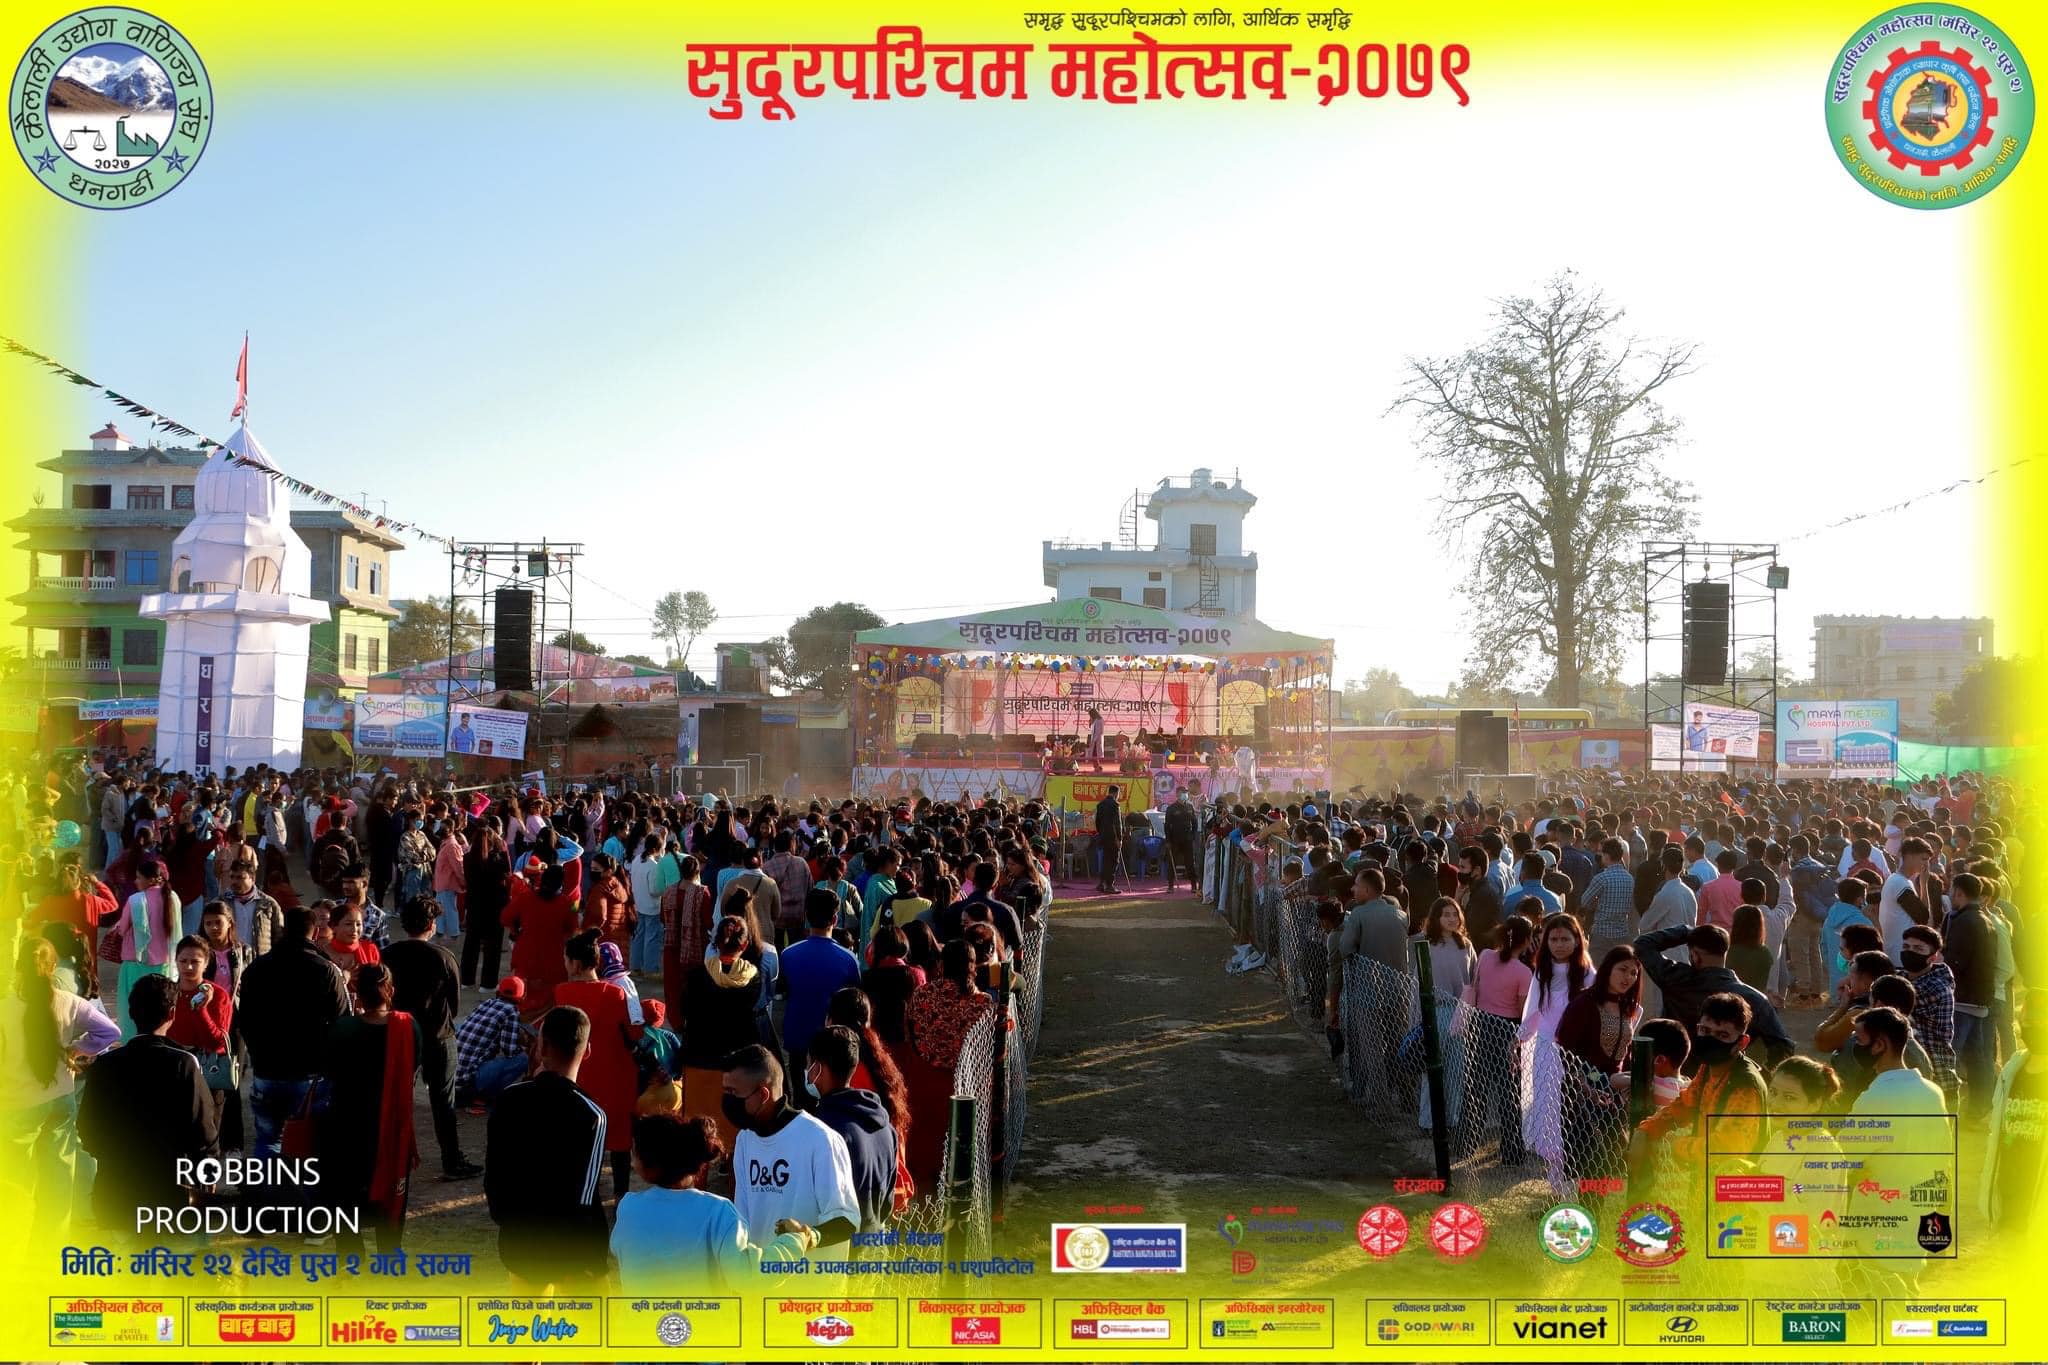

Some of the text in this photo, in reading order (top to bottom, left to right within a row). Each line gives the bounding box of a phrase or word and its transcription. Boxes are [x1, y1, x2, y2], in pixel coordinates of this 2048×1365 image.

[959, 620, 1080, 647] सुदूरपश्चिम
[1807, 710, 1841, 719] MAYA
[1807, 720, 1839, 728] HOSPITAL
[750, 1159, 790, 1187] D&G
